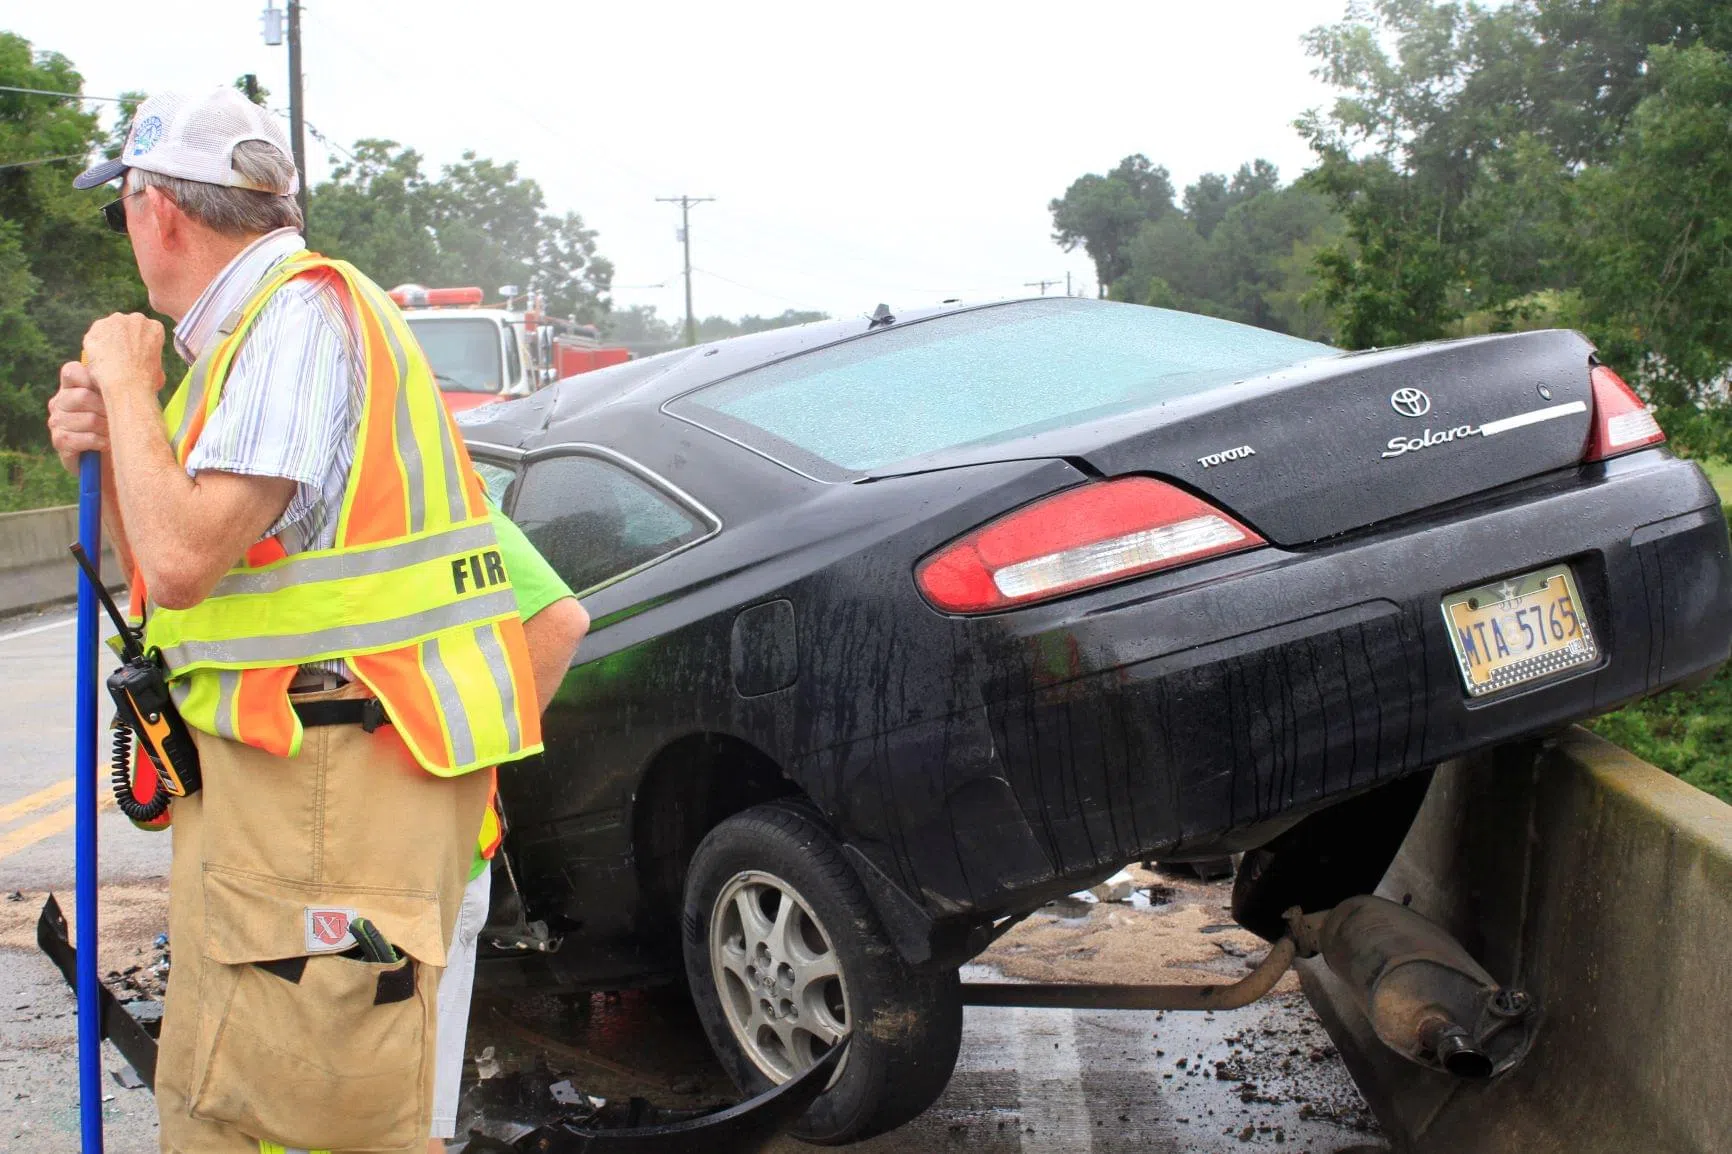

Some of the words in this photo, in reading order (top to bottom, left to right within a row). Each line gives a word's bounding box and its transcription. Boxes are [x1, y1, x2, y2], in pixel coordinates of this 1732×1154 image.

[1197, 445, 1256, 469] TOYOTA
[1381, 422, 1475, 459] Solara
[451, 550, 507, 595] FIR
[1457, 617, 1511, 669] MTA
[1515, 596, 1578, 651] 5765
